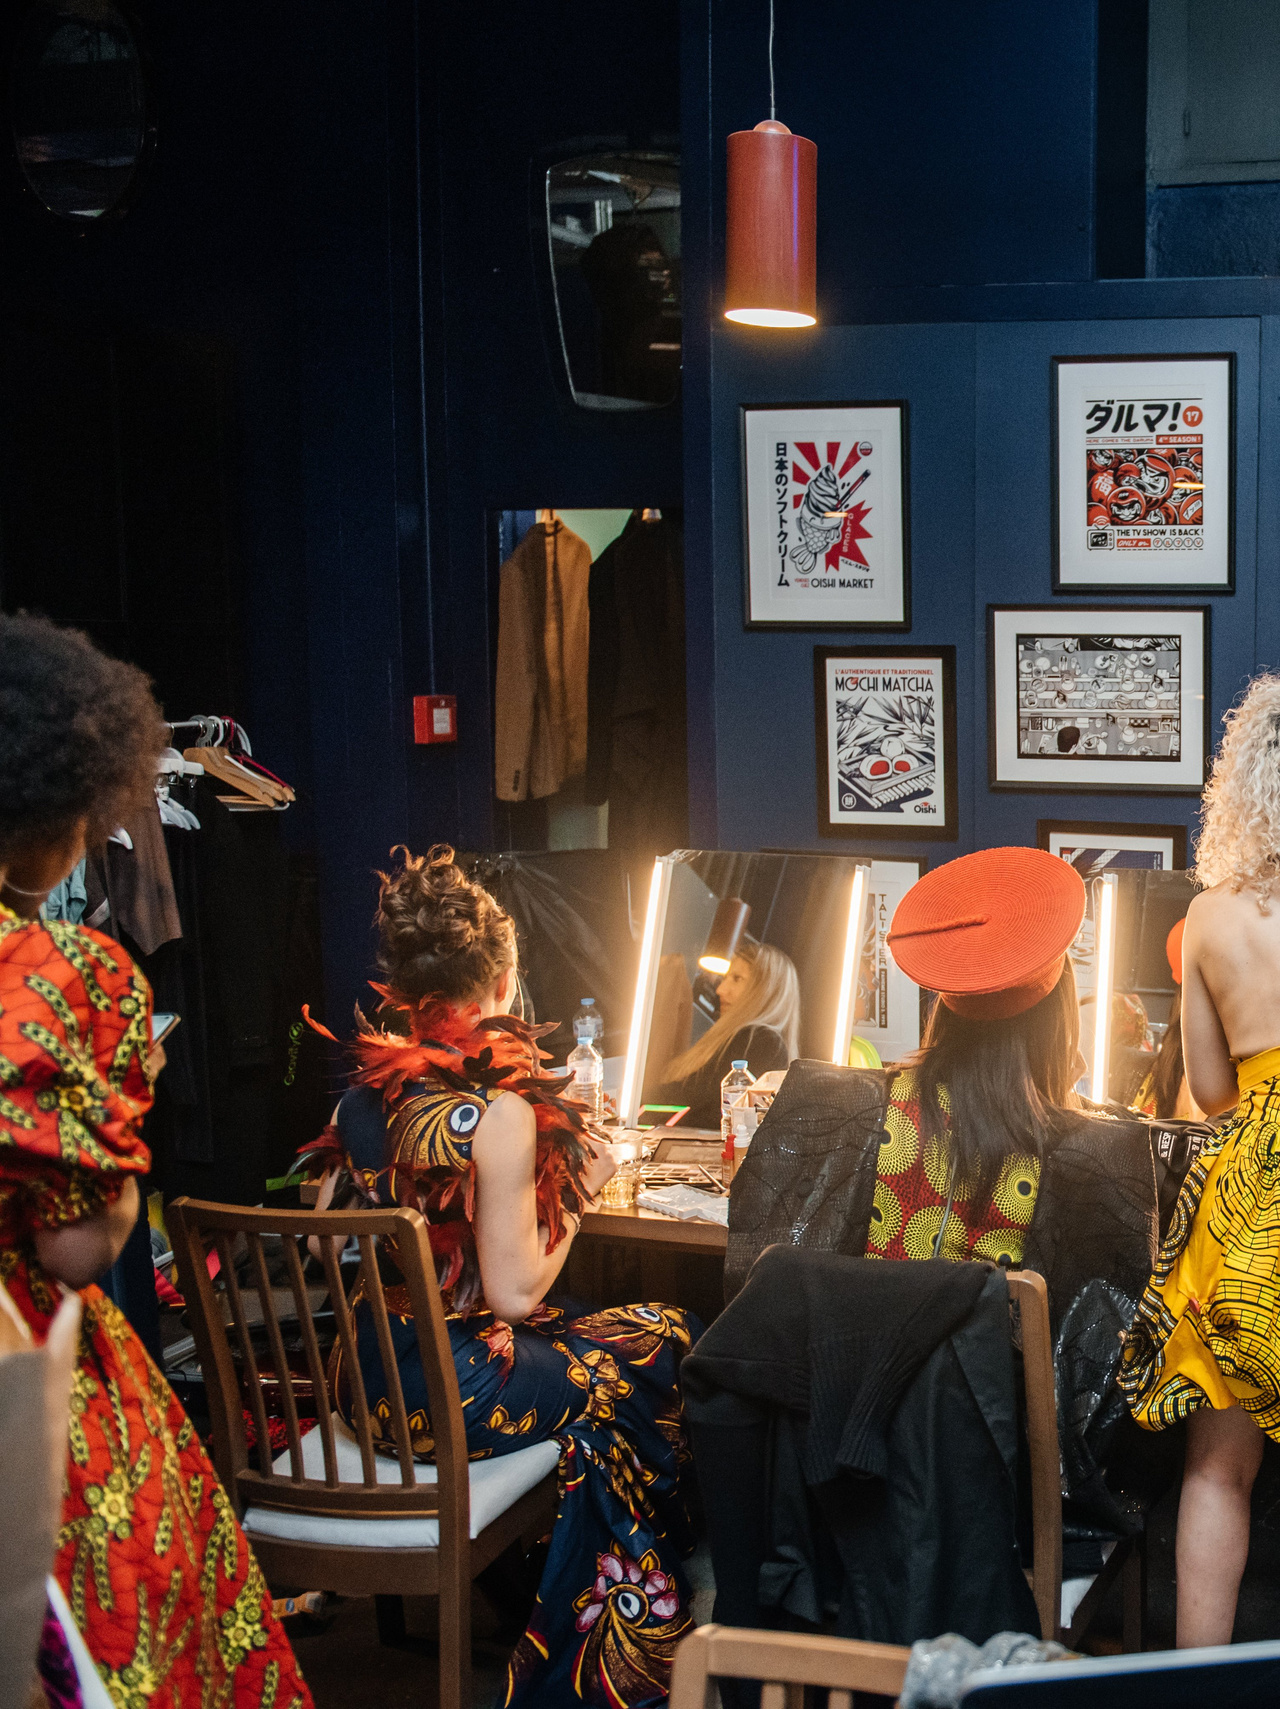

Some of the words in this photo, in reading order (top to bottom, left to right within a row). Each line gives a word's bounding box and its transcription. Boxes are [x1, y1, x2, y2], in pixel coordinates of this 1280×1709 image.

[1186, 410, 1200, 422] 17
[775, 442, 790, 587] 日本のソフトクリーム
[1178, 528, 1200, 536] BACK
[811, 578, 836, 588] OISHI
[839, 578, 874, 589] MARKET
[835, 676, 878, 692] MOCHI
[882, 676, 934, 692] MATCHA
[913, 803, 937, 814] Oishi
